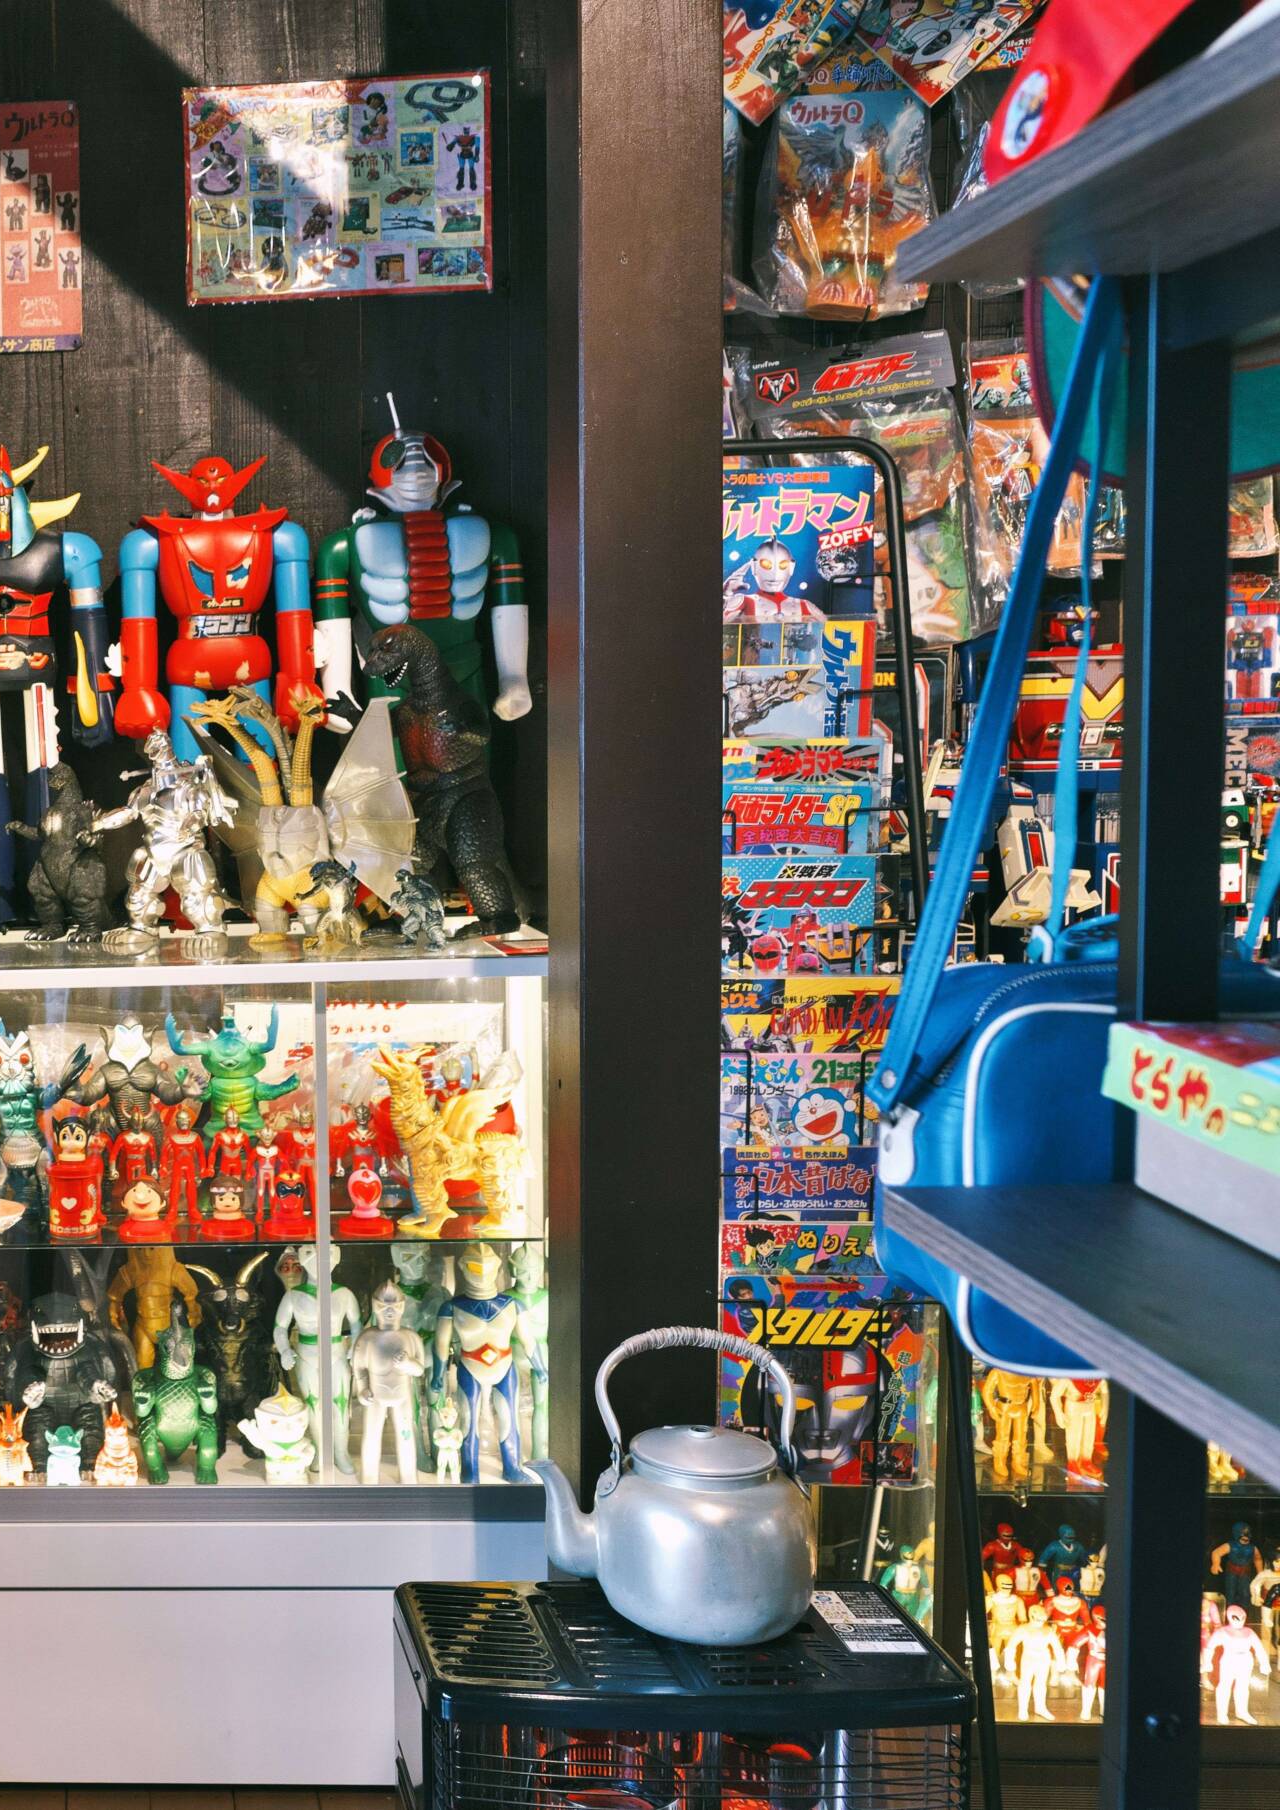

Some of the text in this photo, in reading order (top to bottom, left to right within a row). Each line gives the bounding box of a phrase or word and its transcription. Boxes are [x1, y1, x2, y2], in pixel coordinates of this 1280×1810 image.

[4, 110, 75, 142] ウルトラQ
[791, 101, 864, 125] ウルトラQ
[752, 360, 780, 370] unifive
[819, 524, 874, 550] ZOFFY
[758, 746, 844, 777] ウルトラマン
[1224, 727, 1249, 792] MEC
[743, 828, 840, 846] 全秘密大百科
[738, 879, 869, 909] マスクマン
[770, 1006, 846, 1036] GUNDAM
[721, 1058, 804, 1085] ドラえもん
[811, 1059, 880, 1085] 21エモ
[735, 1165, 749, 1199] まんが
[750, 1164, 876, 1198] 日本昔ばな
[797, 1231, 862, 1256] ぬりえ
